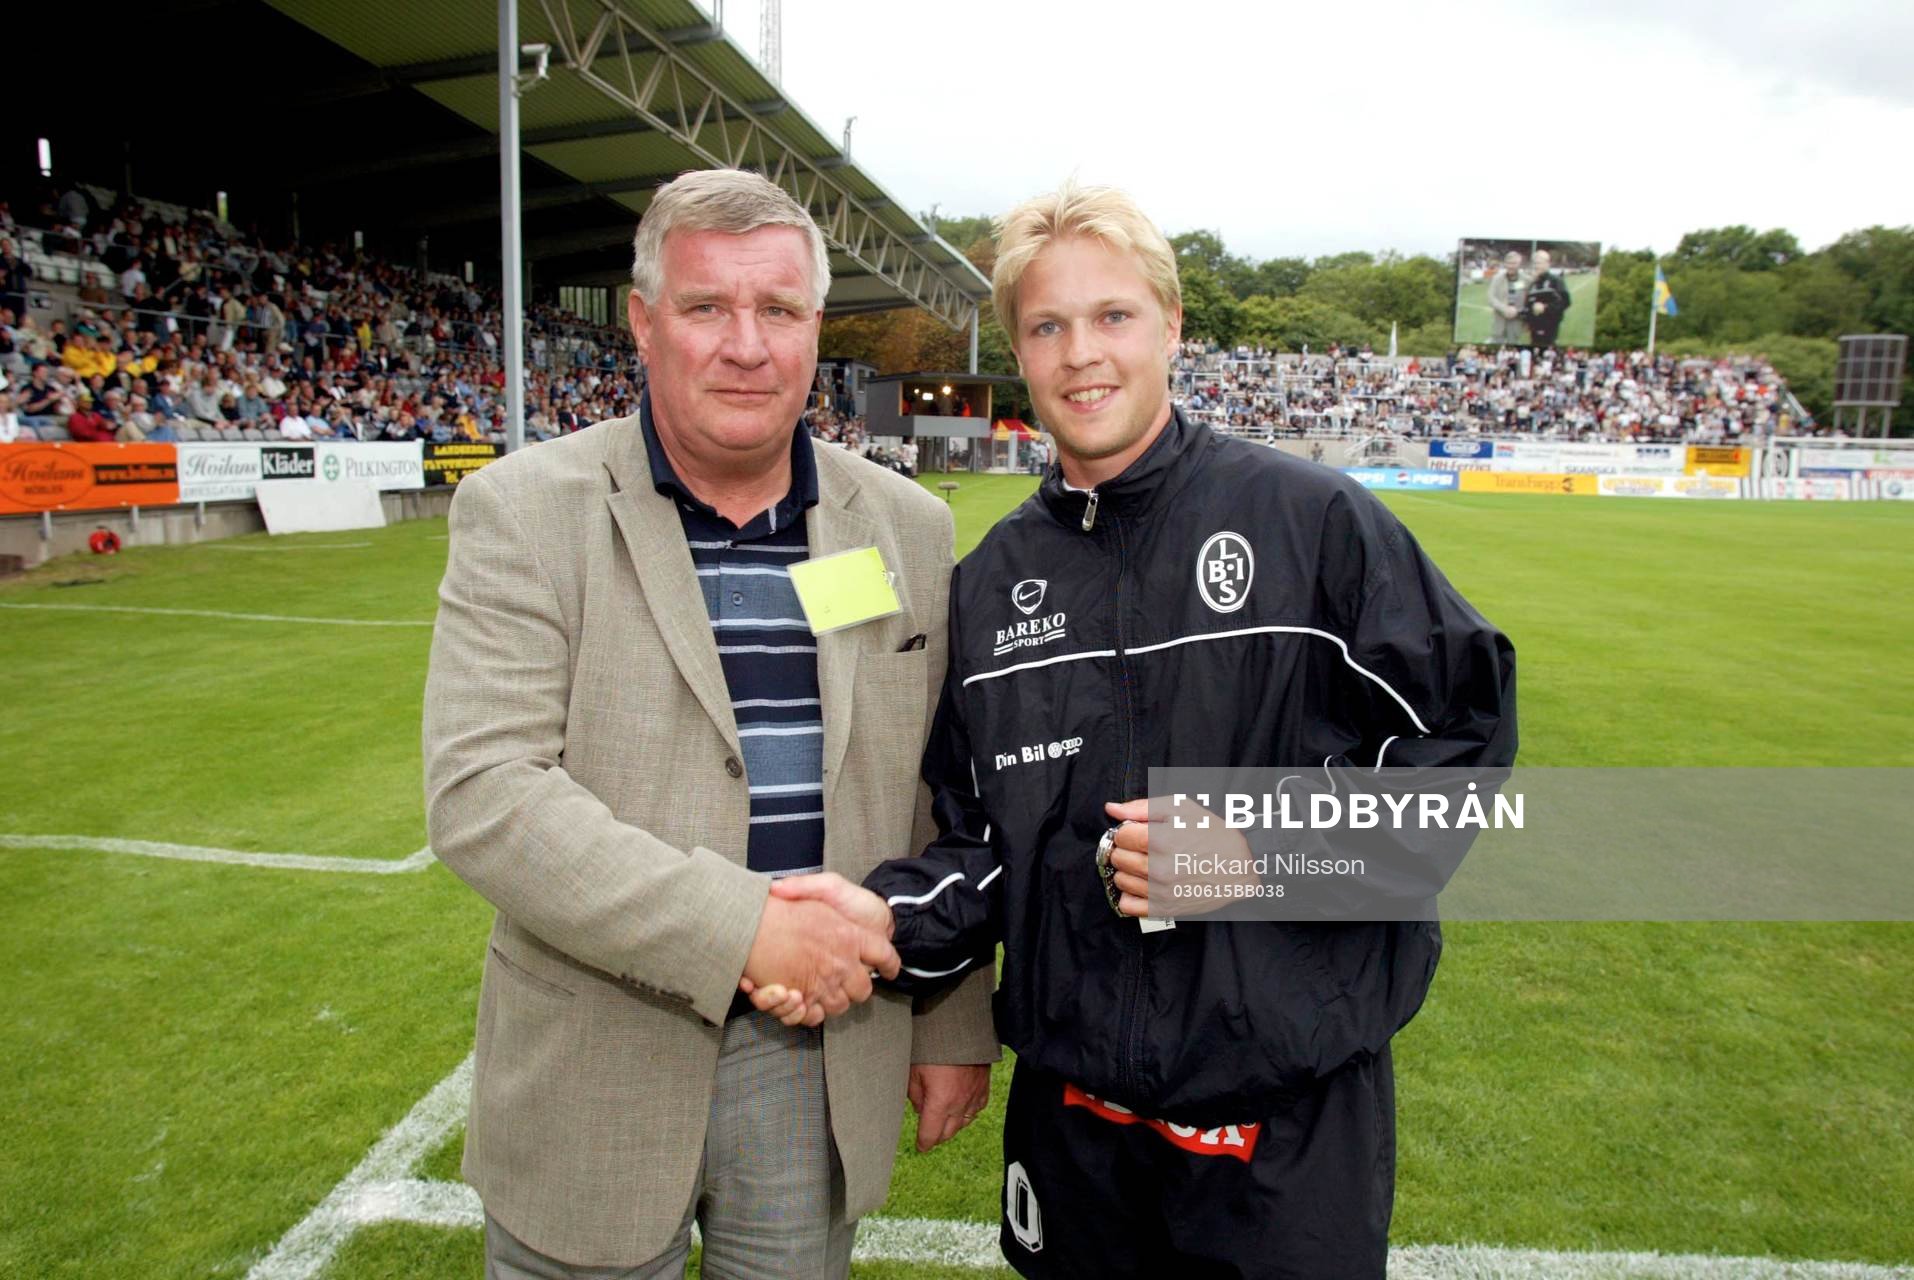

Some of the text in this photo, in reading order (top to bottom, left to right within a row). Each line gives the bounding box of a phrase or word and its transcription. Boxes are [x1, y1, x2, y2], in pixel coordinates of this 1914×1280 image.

[262, 452, 315, 475] Kläder
[345, 457, 421, 478] PILKINGTON
[1412, 474, 1454, 485] PEPSI
[995, 612, 1066, 646] BAREKO
[1012, 636, 1045, 649] SPORT
[995, 751, 1017, 771] Din
[1021, 743, 1045, 763] Bil
